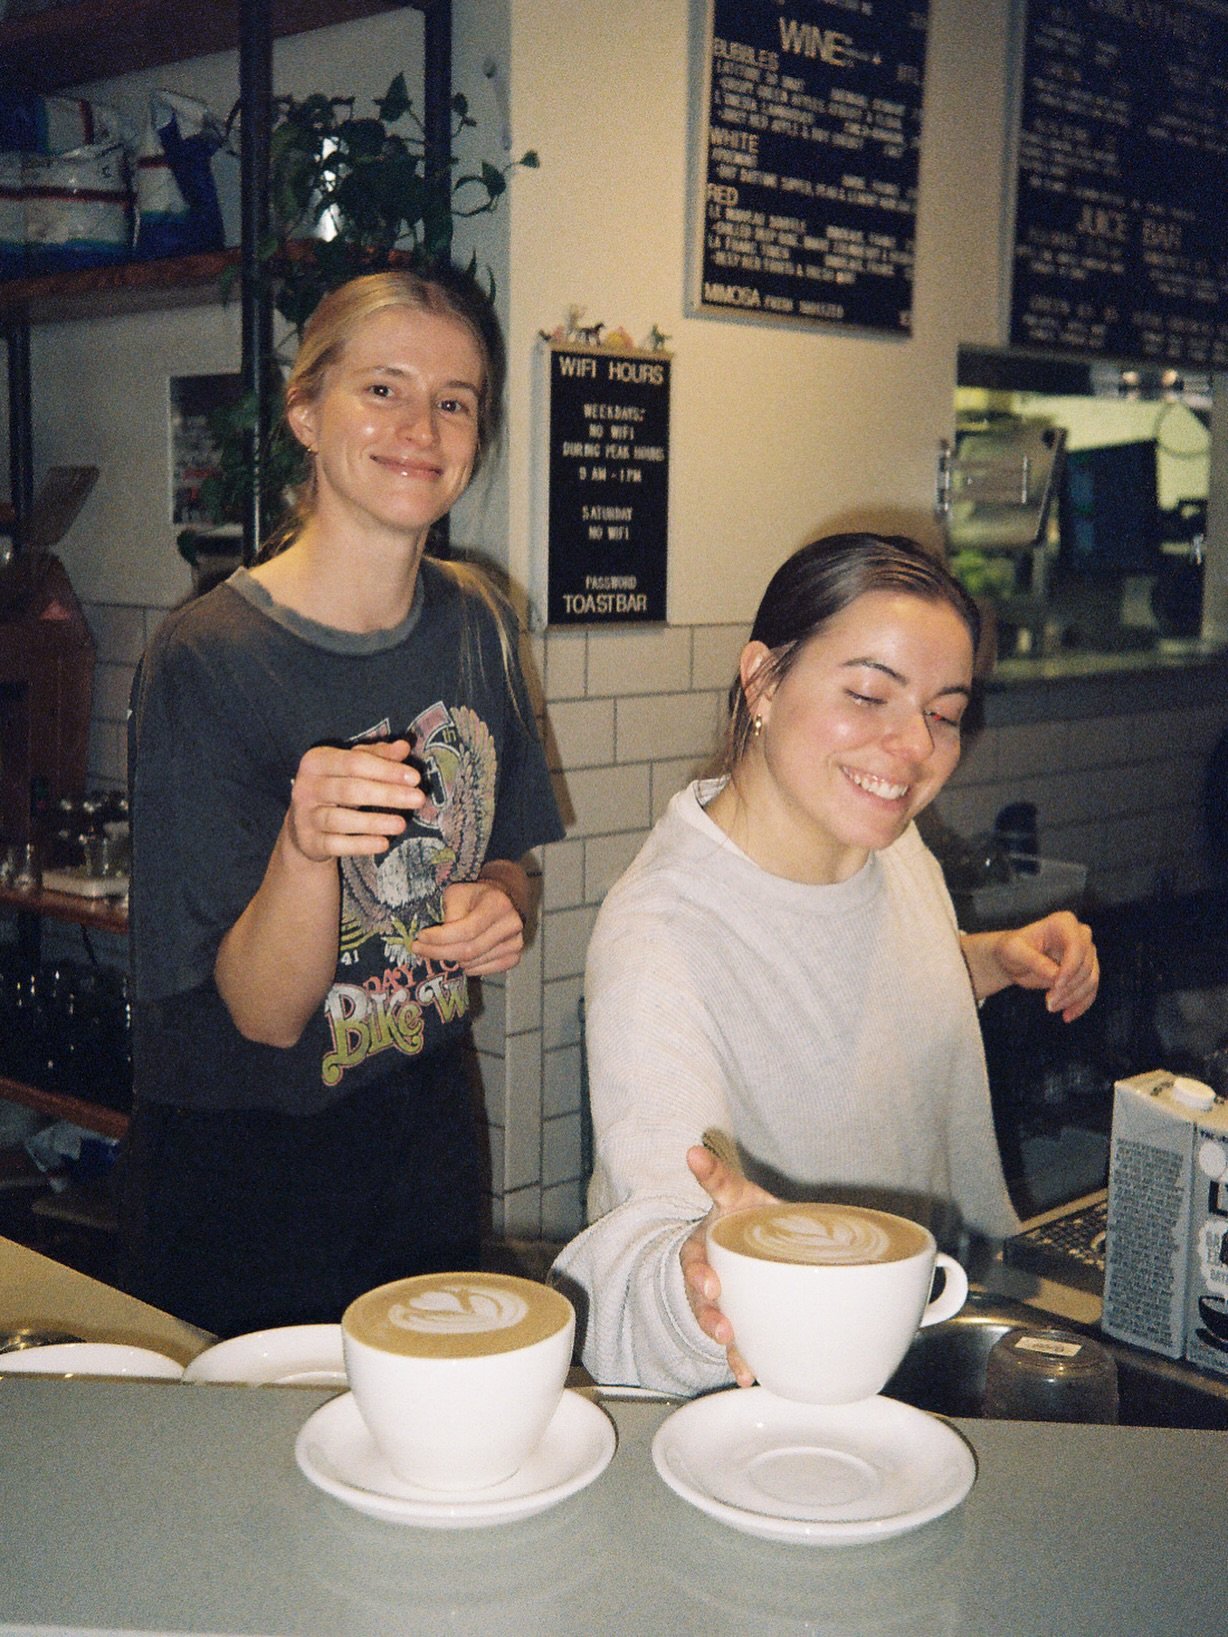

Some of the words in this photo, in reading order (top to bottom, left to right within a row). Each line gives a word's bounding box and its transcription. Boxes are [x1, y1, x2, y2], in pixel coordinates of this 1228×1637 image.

[779, 16, 853, 68] WINE
[709, 126, 759, 153] WHITE
[706, 182, 739, 206] RED
[559, 355, 597, 378] WIFI
[608, 360, 665, 385] HOURS
[588, 423, 603, 438] NO
[610, 424, 634, 440] WIFI
[562, 441, 601, 458] DURING
[582, 505, 633, 521] SATURDAY
[588, 525, 603, 541] NO
[607, 526, 629, 541] WIFI
[585, 575, 638, 590] PASSWORD
[562, 593, 648, 614] TOASTBAR
